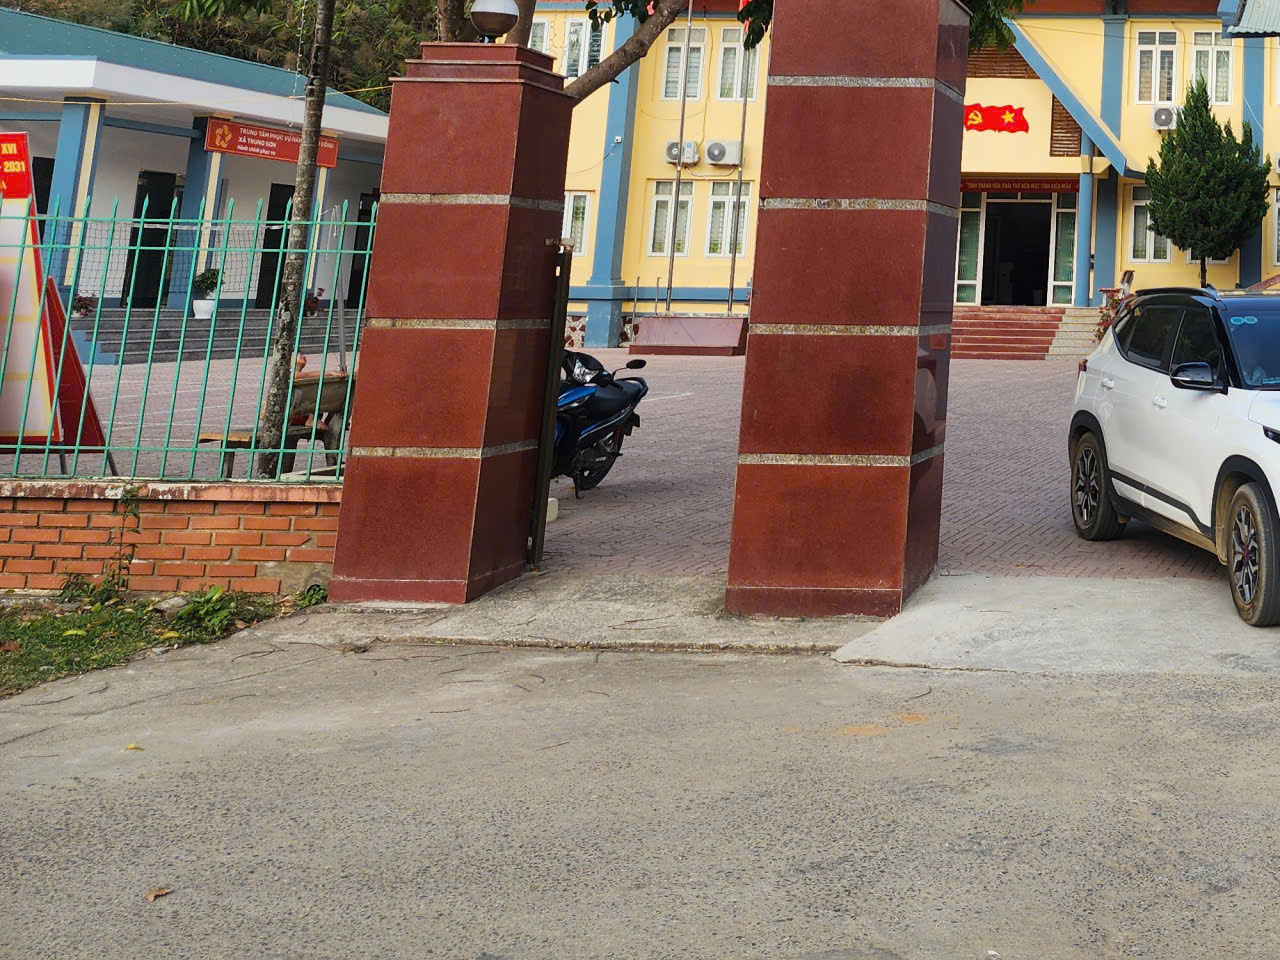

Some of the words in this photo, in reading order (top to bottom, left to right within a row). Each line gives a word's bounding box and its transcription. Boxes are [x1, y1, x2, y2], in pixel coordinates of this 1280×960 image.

[240, 127, 258, 136] TRUNG
[258, 128, 270, 138] TÂM
[269, 132, 284, 142] PHỤC
[247, 137, 265, 146] TRUNG
[265, 140, 277, 148] SƠN
[1, 143, 17, 155] XVI
[3, 160, 26, 173] 2031
